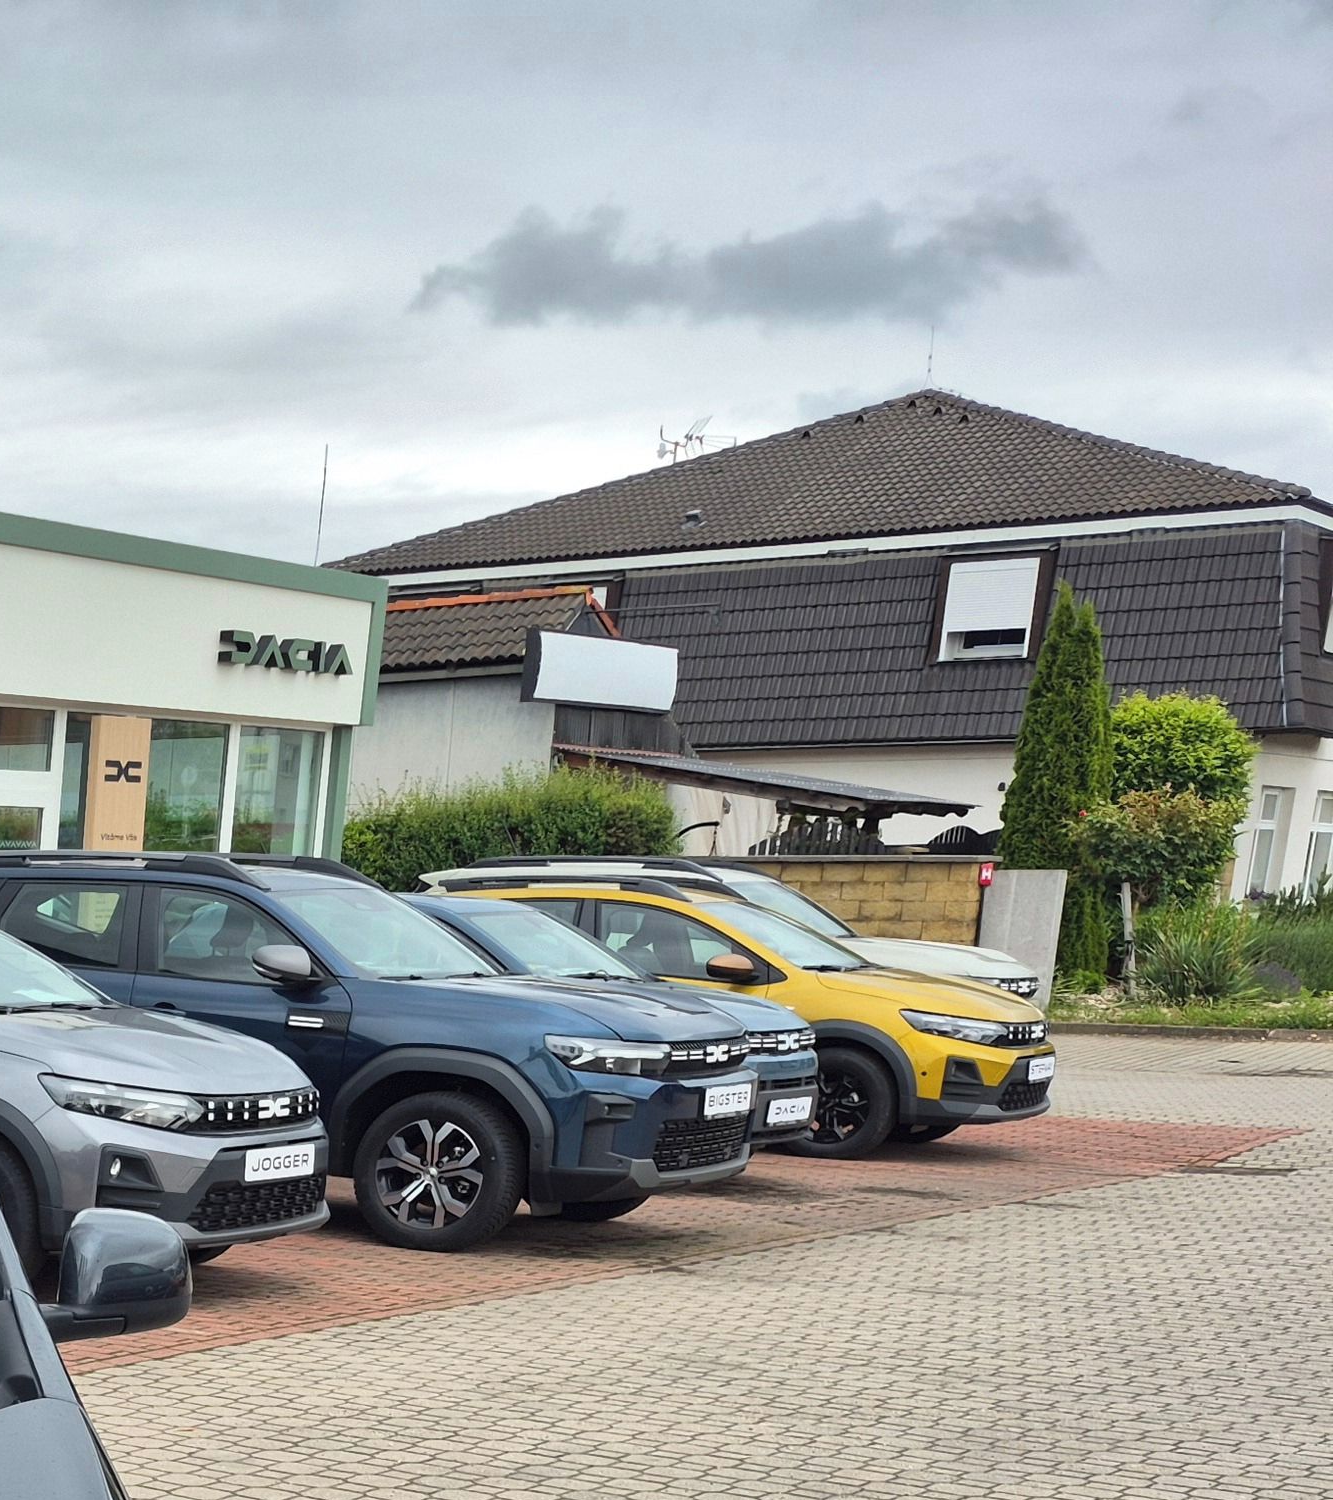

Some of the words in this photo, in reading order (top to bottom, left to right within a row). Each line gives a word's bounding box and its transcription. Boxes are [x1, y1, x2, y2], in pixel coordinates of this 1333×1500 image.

[218, 630, 353, 675] DACIA
[708, 1091, 748, 1107] BIGSTER
[775, 1105, 806, 1116] DACIA
[251, 1153, 309, 1172] JOGGER
